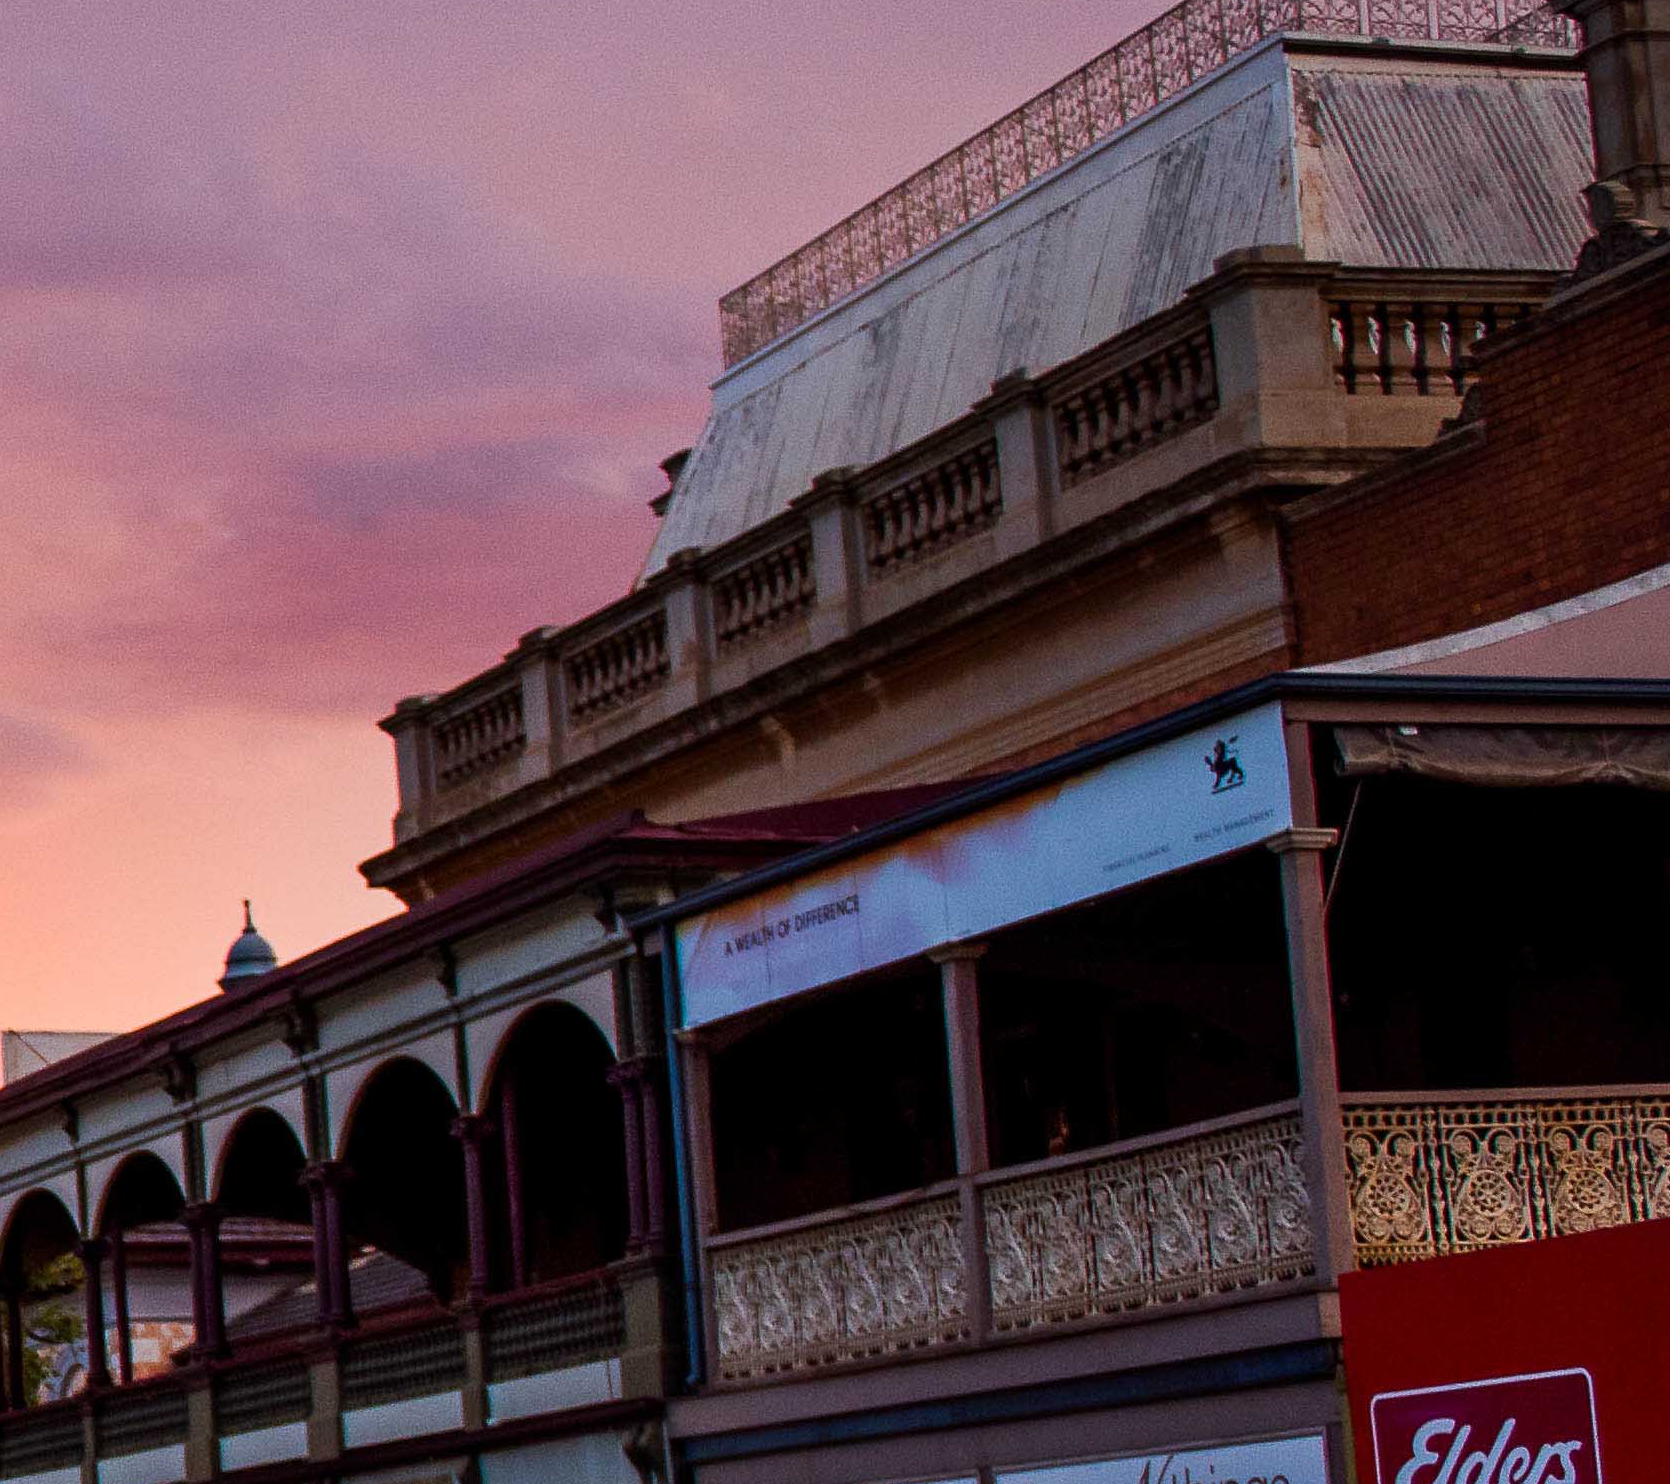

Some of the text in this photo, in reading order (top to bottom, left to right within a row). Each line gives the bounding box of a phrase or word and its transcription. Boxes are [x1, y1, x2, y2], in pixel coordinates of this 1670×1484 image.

[724, 892, 861, 957] A WEALTH OF DIFFERENCE
